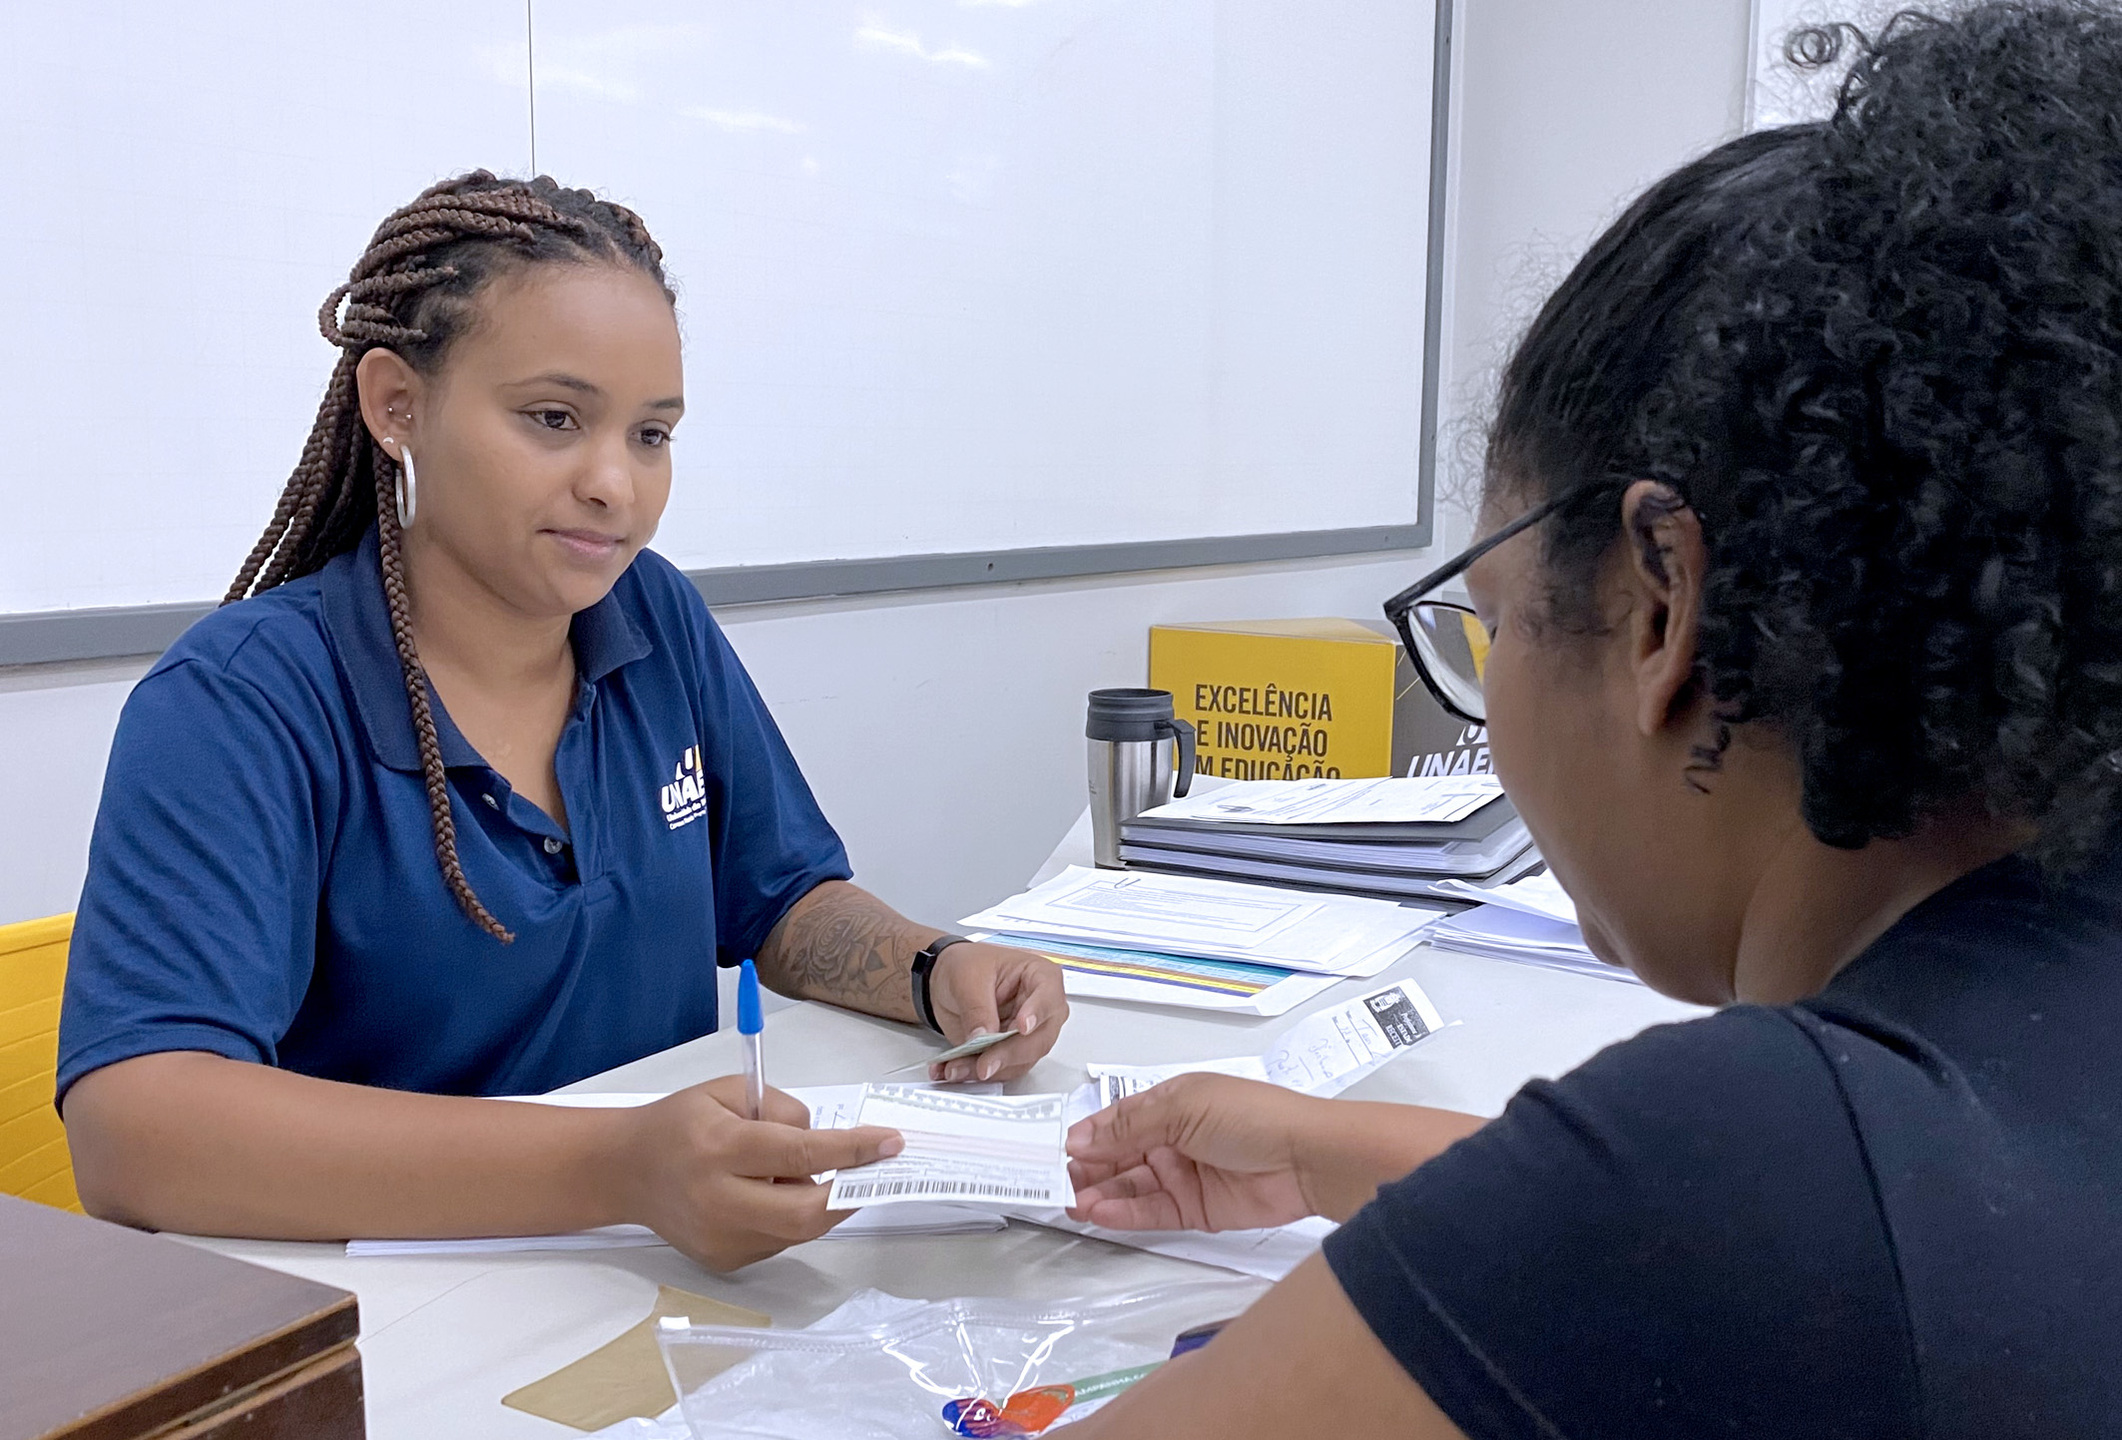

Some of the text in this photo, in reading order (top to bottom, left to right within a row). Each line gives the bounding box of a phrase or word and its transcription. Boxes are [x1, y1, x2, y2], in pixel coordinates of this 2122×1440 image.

[1195, 683, 1333, 721] EXCELÊNCIA
[1196, 719, 1328, 762] E INOVAÇÃO
[1195, 754, 1213, 776] M
[1407, 747, 1494, 778] UNAE
[661, 770, 706, 813] UNAE
